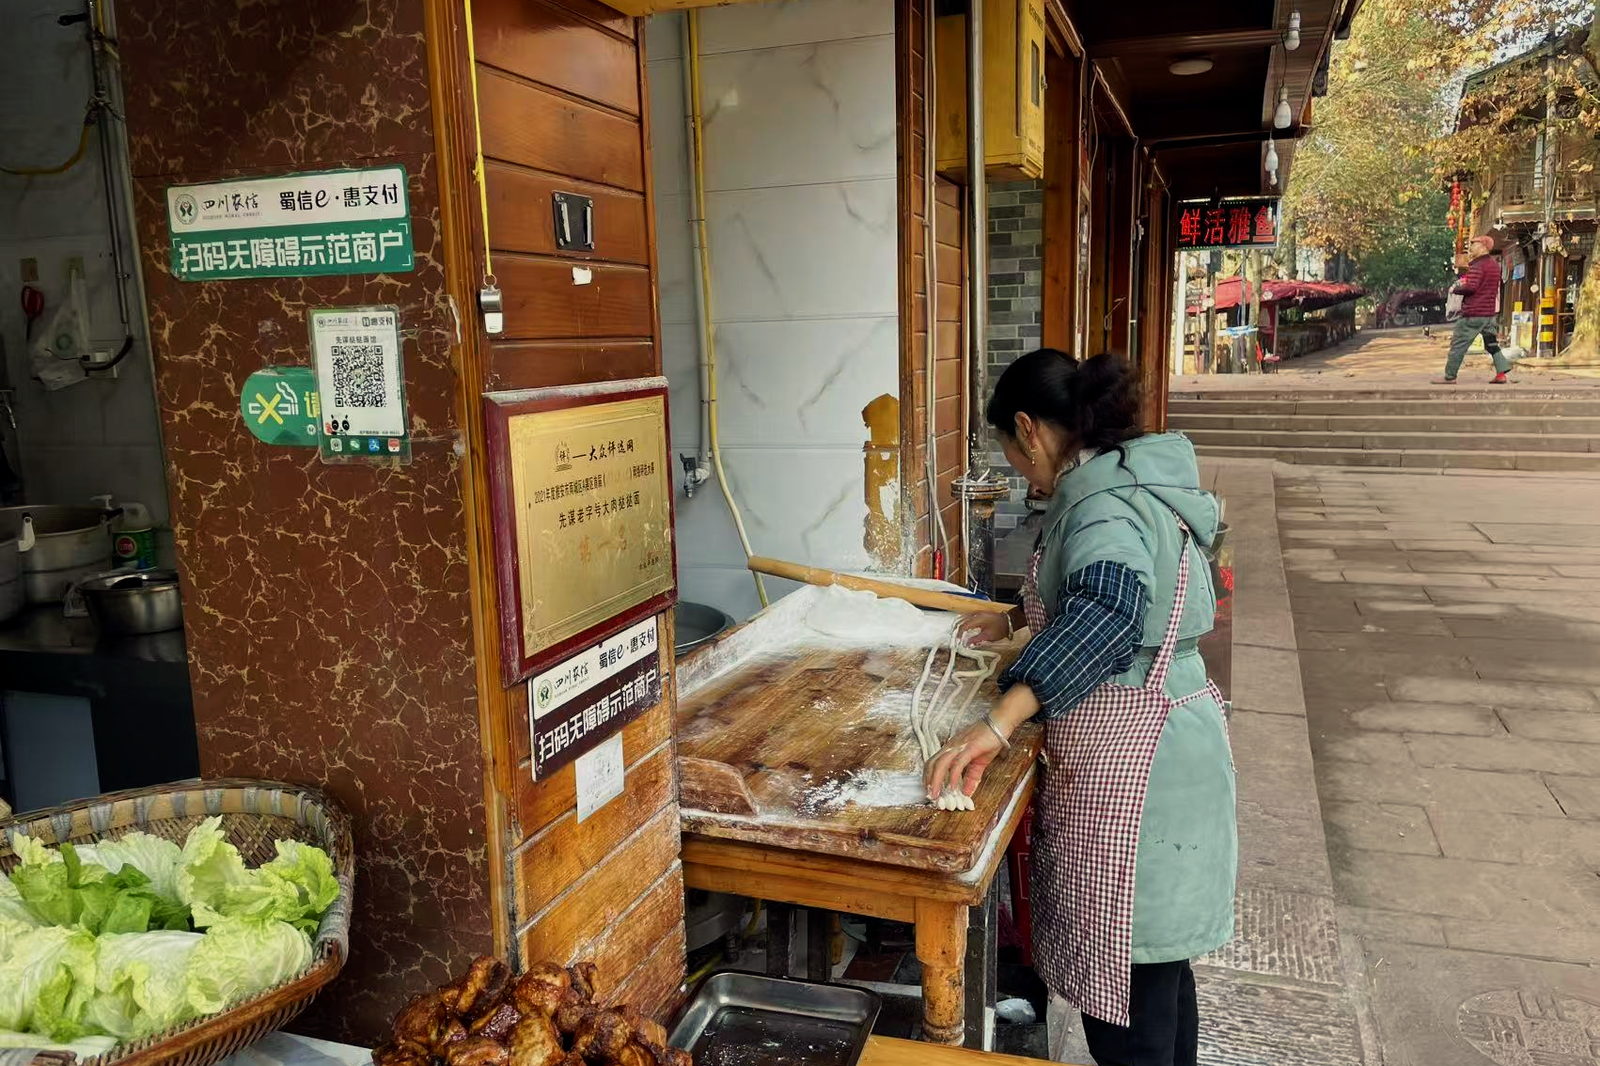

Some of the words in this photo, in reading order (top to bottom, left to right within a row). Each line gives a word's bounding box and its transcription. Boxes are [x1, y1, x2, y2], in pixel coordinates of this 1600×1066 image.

[202, 193, 259, 212] 四川农信
[1180, 205, 1275, 245] 鲜活雅鱼
[179, 230, 403, 272] 扫码无障碍示范商户
[538, 669, 658, 763] 扫码无障碍示范商户
